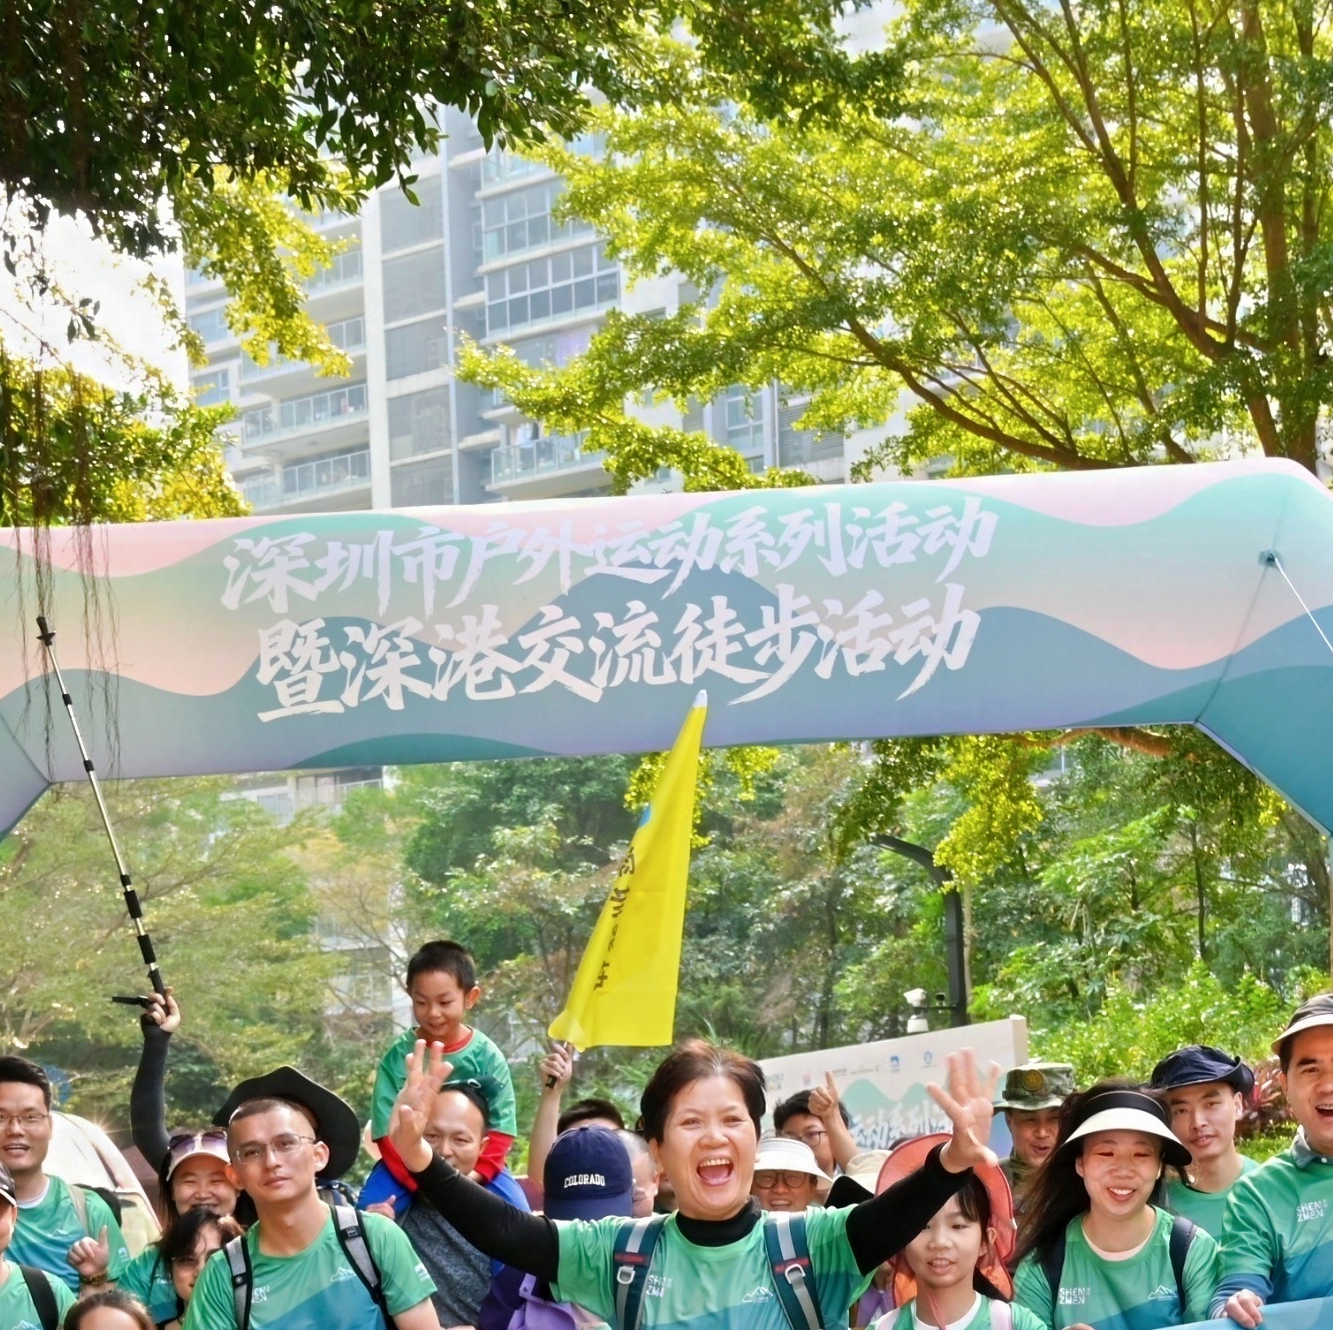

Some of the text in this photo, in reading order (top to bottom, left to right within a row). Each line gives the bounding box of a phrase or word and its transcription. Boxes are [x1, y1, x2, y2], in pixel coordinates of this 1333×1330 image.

[221, 496, 998, 616] 深圳市户外运动系列活动
[257, 584, 982, 723] 暨深港交流徒步活动
[564, 1173, 606, 1188] COLORADO
